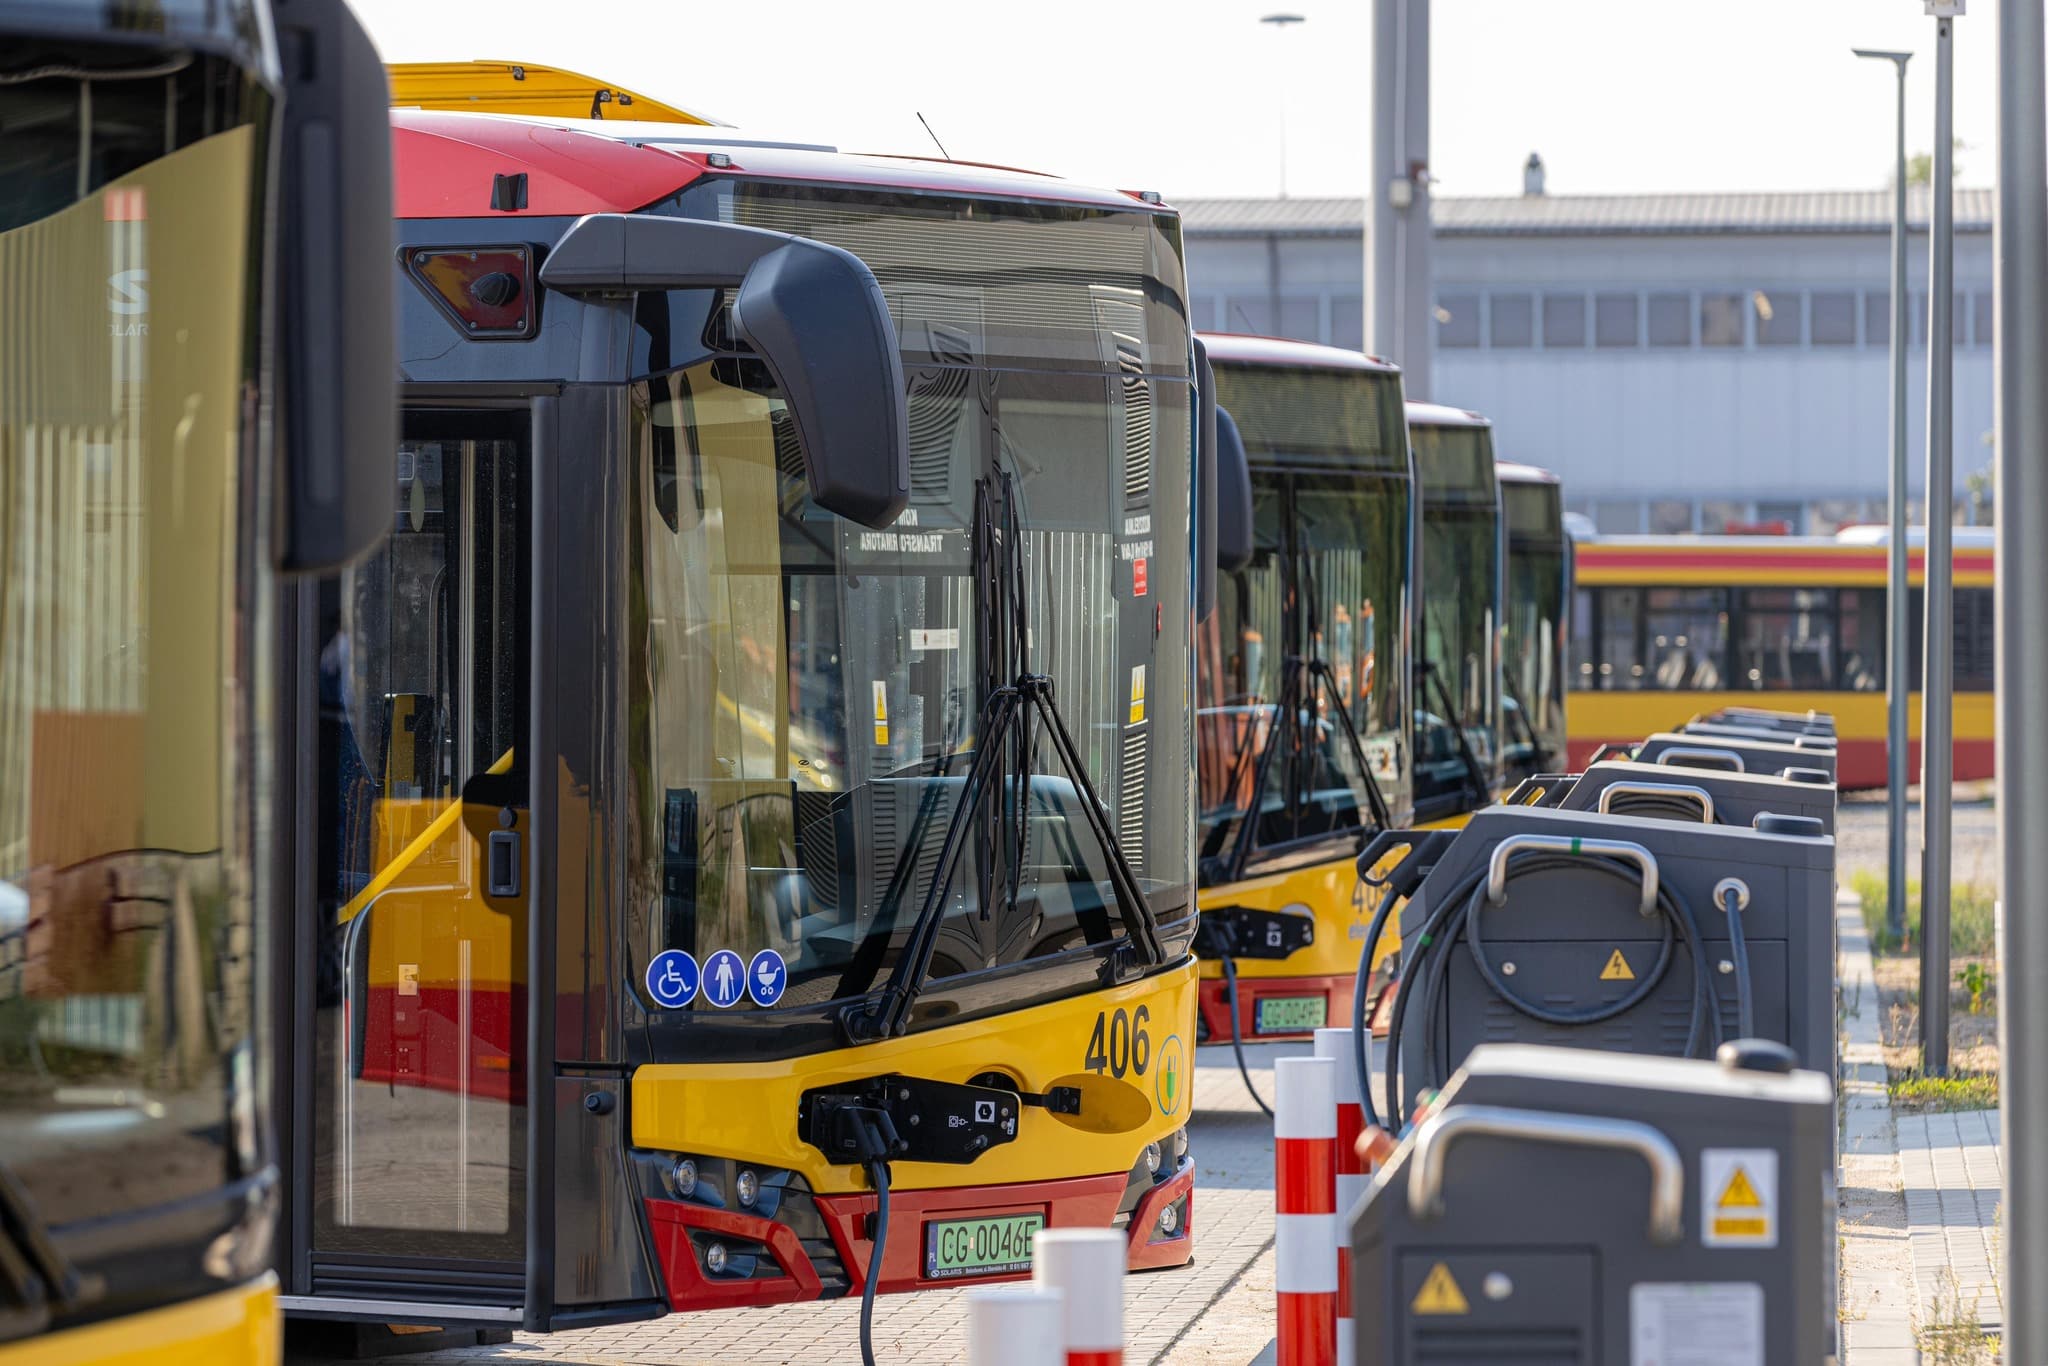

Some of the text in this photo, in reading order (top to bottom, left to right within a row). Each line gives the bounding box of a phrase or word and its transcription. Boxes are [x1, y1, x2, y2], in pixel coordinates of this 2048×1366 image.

[1085, 1004, 1150, 1079] 406
[942, 1220, 1037, 1264] CG 0046E
